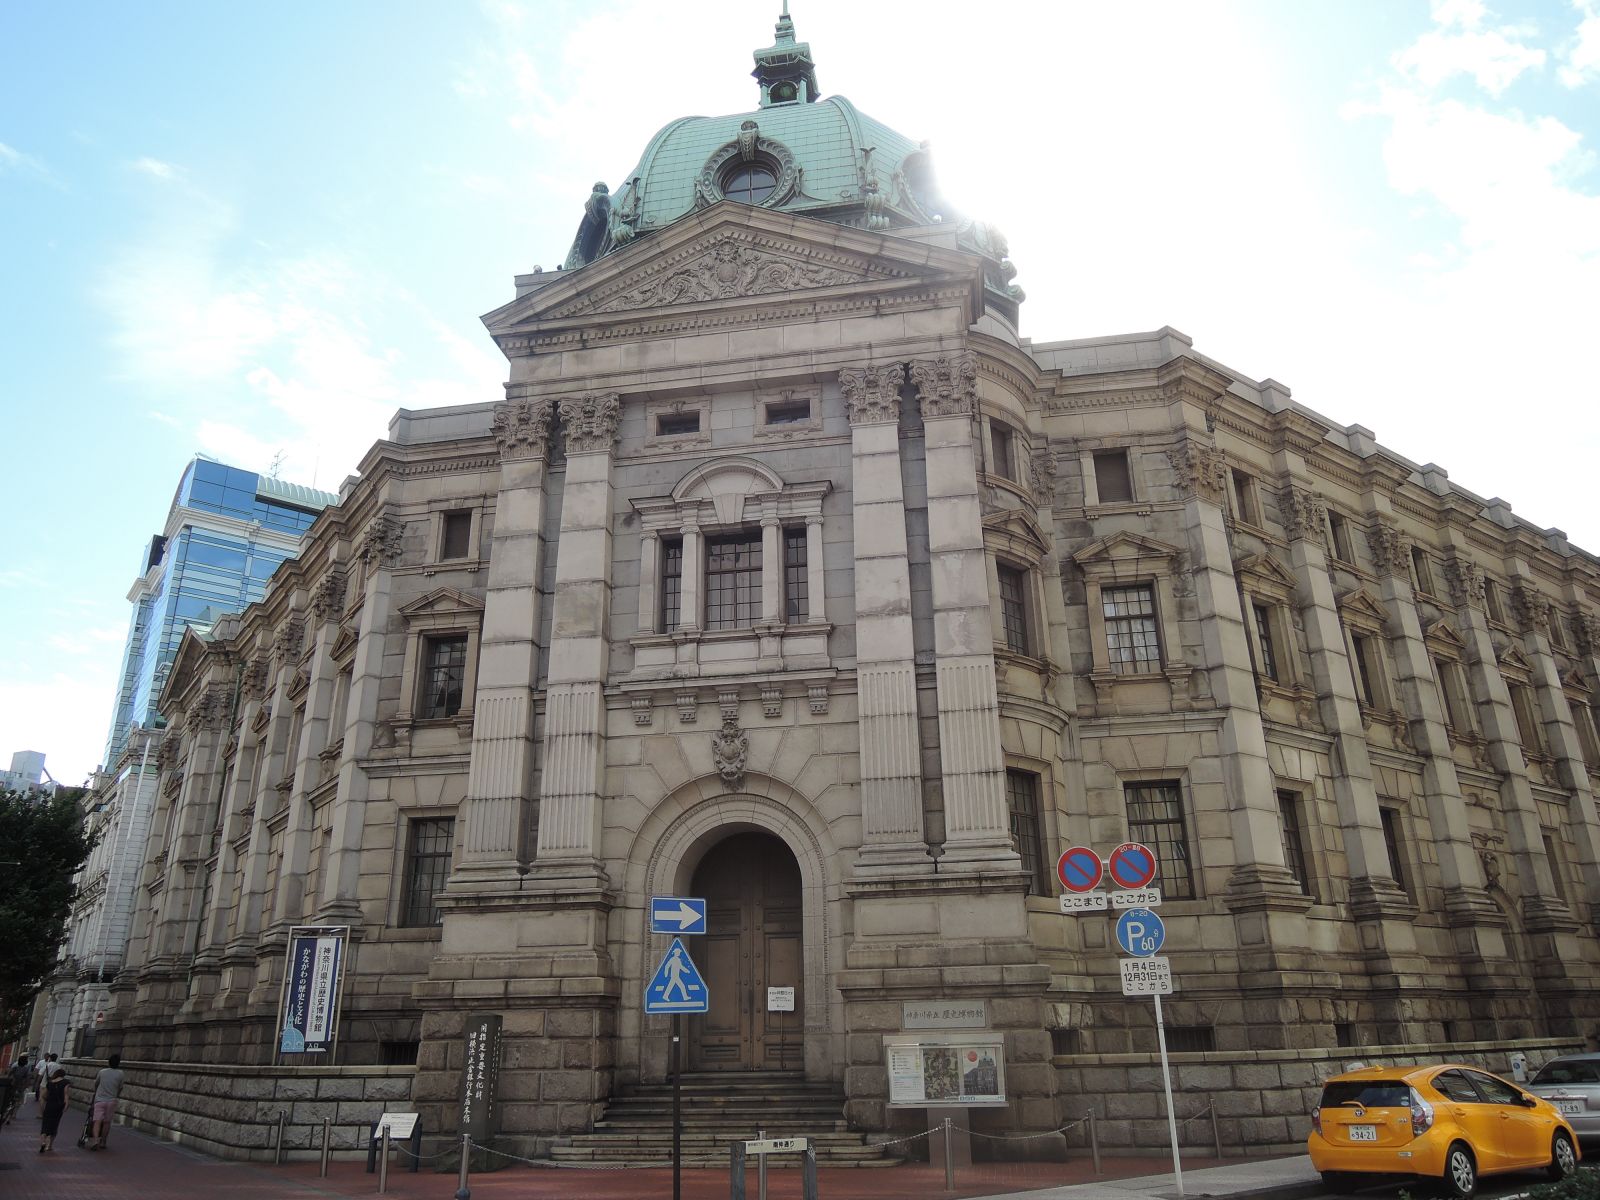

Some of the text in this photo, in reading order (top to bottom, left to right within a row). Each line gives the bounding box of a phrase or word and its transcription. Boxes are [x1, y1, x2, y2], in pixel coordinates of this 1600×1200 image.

[1063, 896, 1104, 908] ここまで
[1115, 892, 1158, 905] ここから
[1126, 922, 1145, 952] P
[294, 947, 311, 1026] かながわの歴史と文化
[313, 947, 332, 1032] 神奈川県立歴史博物館
